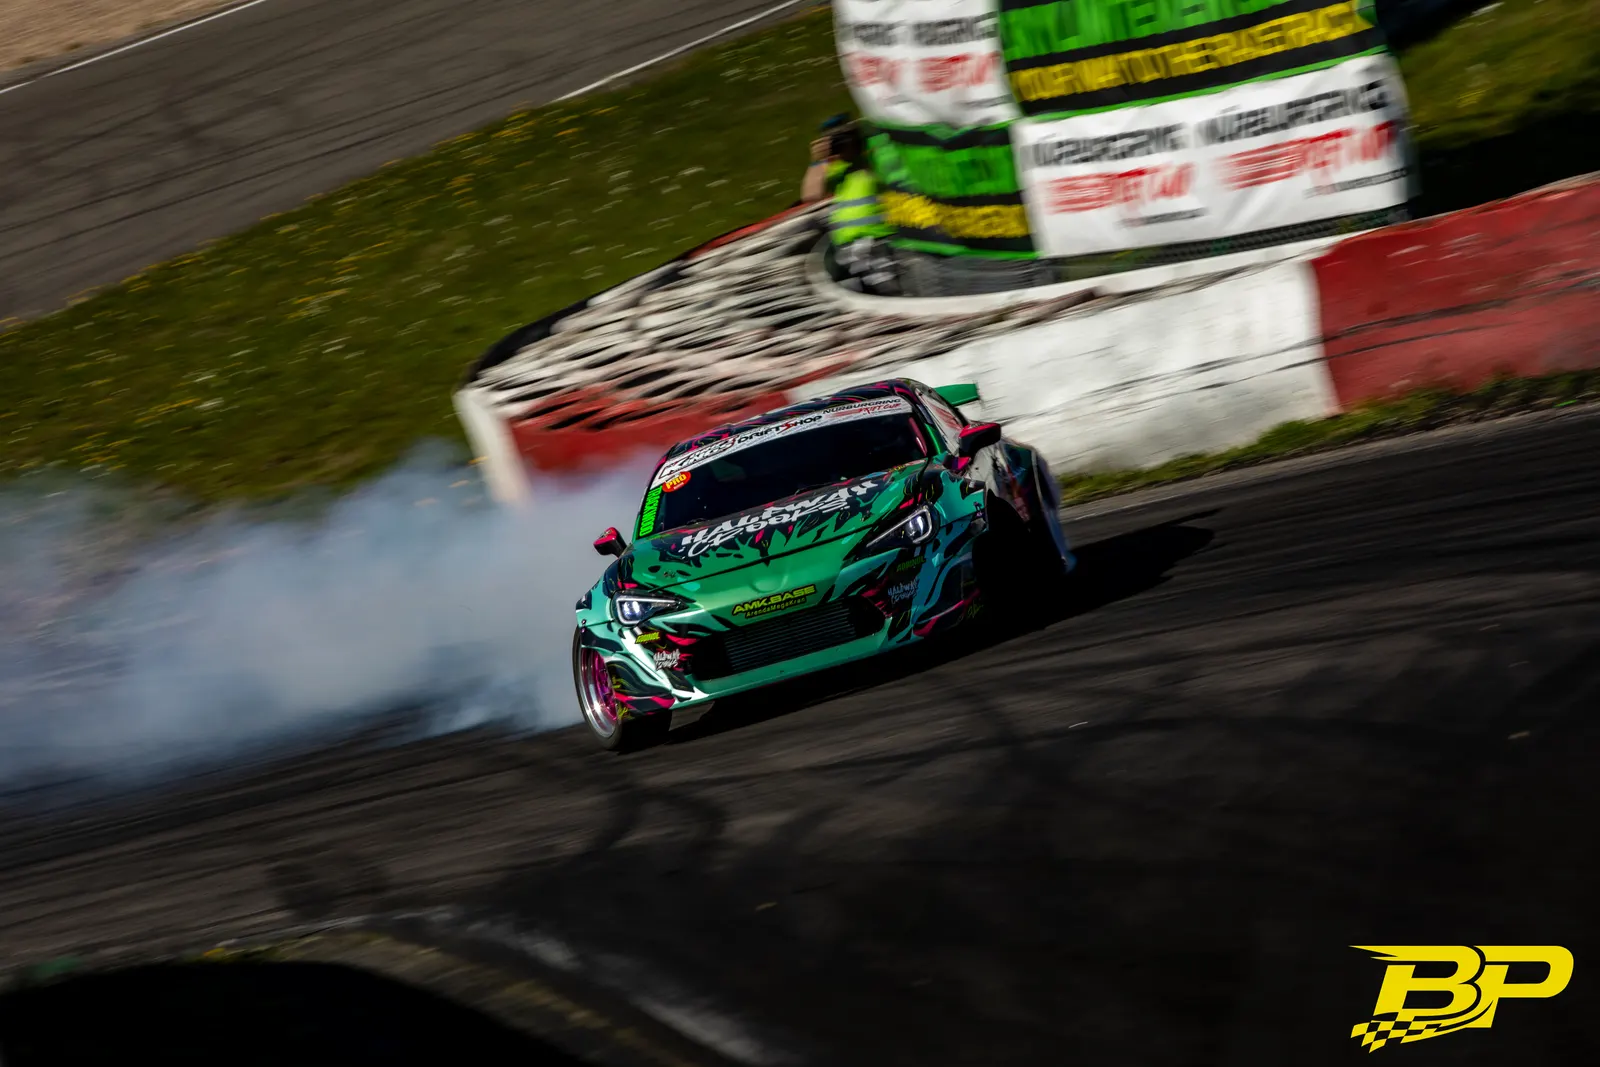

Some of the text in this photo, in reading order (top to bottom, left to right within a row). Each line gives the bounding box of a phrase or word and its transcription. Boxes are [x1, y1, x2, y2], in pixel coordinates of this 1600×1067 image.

[665, 473, 687, 489] PRO
[682, 480, 878, 545] HALFWAY
[733, 585, 815, 615] AMK.BASE
